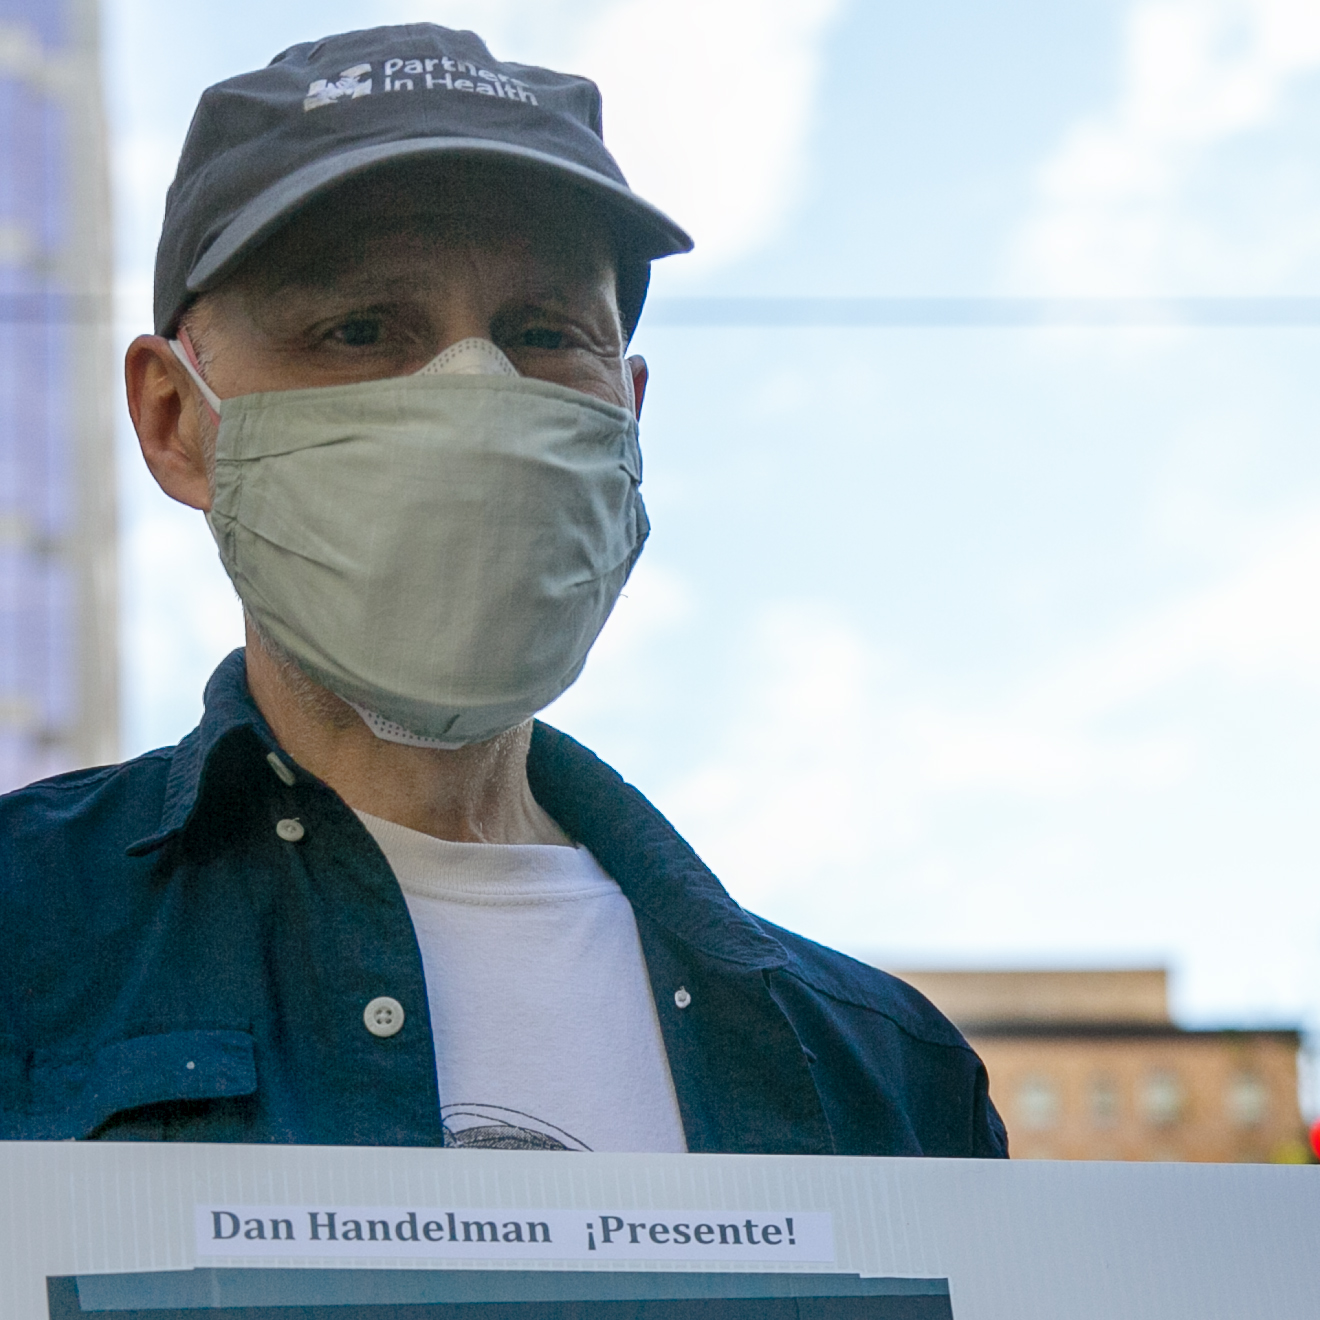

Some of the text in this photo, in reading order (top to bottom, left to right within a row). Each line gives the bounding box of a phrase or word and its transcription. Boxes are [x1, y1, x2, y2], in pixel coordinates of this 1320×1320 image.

[384, 72, 539, 106] in Health
[211, 1210, 797, 1251] Dan Handelman ¡Presente!
